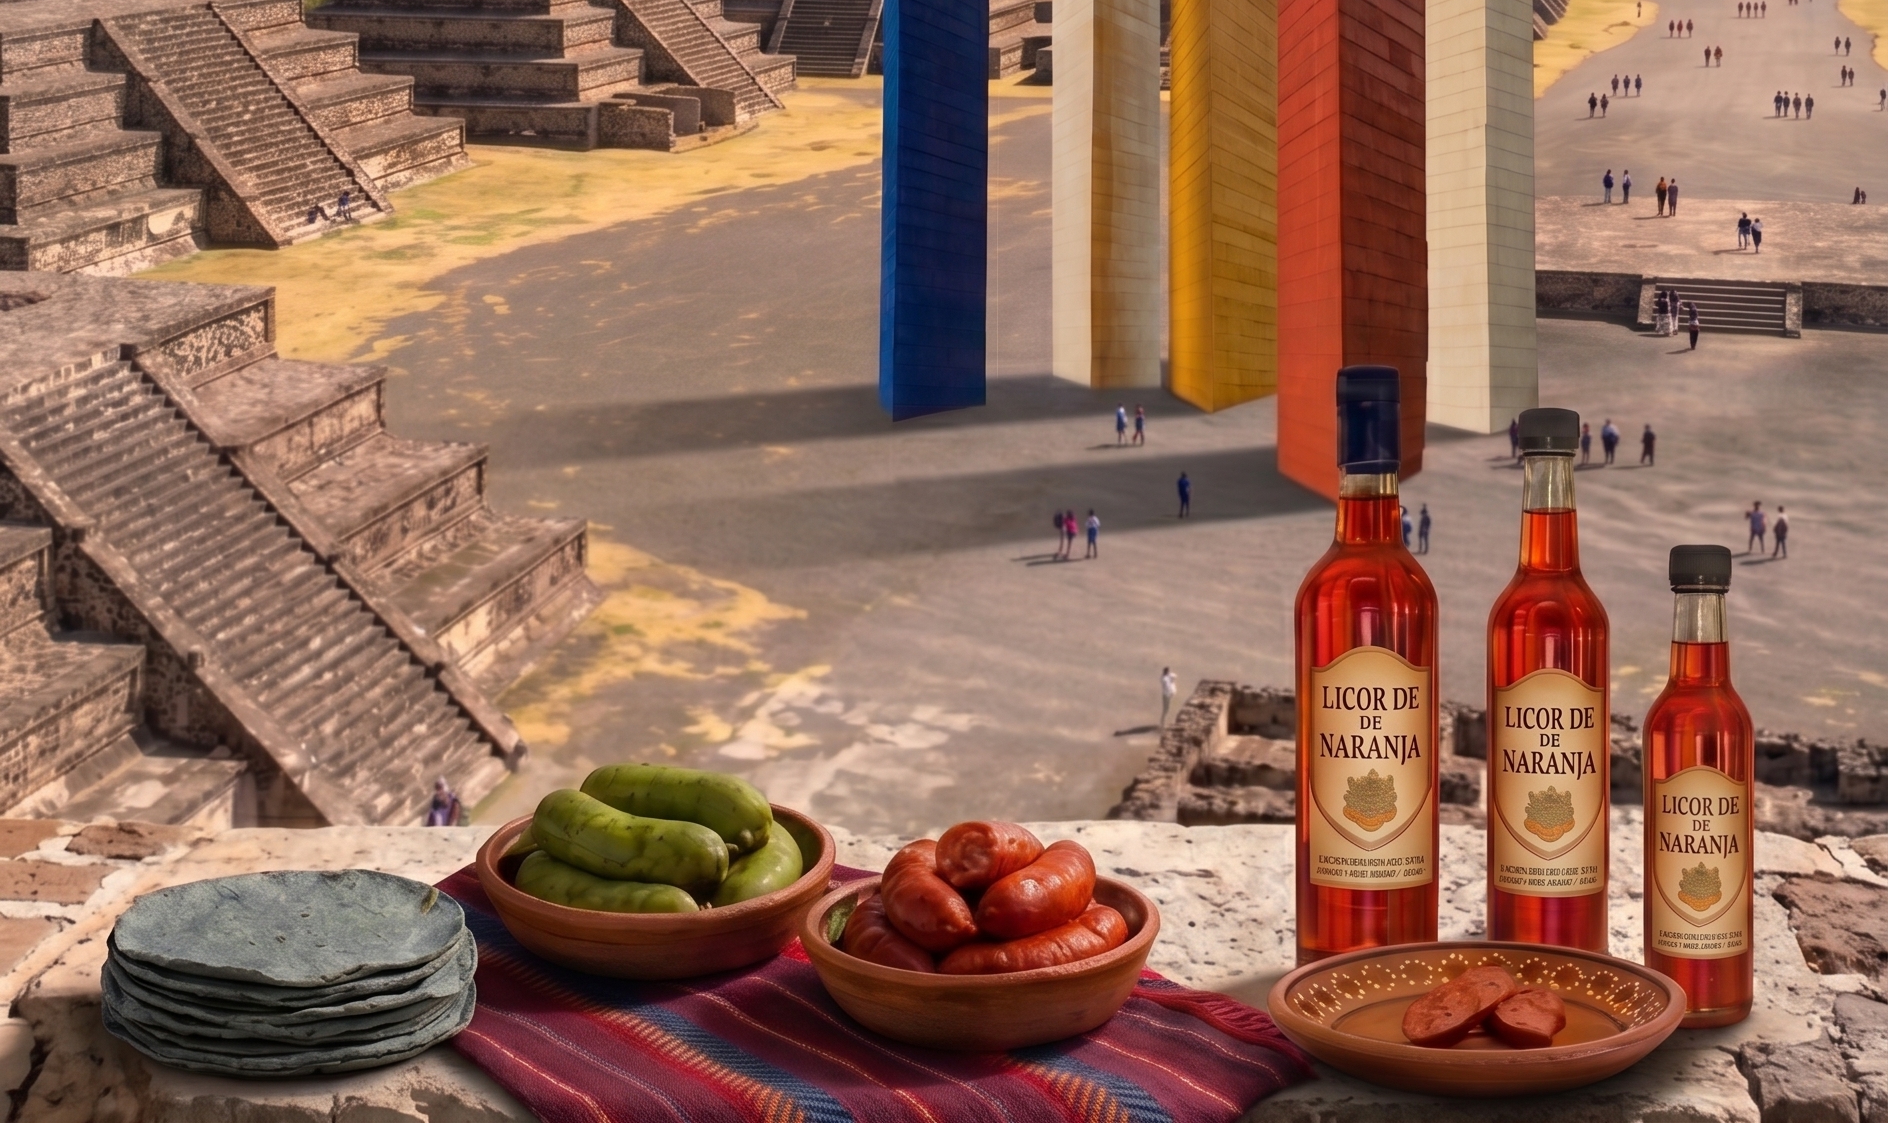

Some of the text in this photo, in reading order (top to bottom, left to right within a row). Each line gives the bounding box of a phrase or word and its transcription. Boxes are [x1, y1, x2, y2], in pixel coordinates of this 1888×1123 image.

[1322, 685, 1420, 711] LICOR DE
[1360, 715, 1382, 730] DE
[1504, 706, 1595, 730] LICOR DE
[1320, 733, 1421, 765] NARANJA
[1540, 733, 1560, 747] DE
[1502, 749, 1597, 780] NARANJA
[1662, 794, 1739, 816] LICOR DE
[1692, 819, 1710, 831] DE
[1659, 831, 1739, 859] NARANJA
